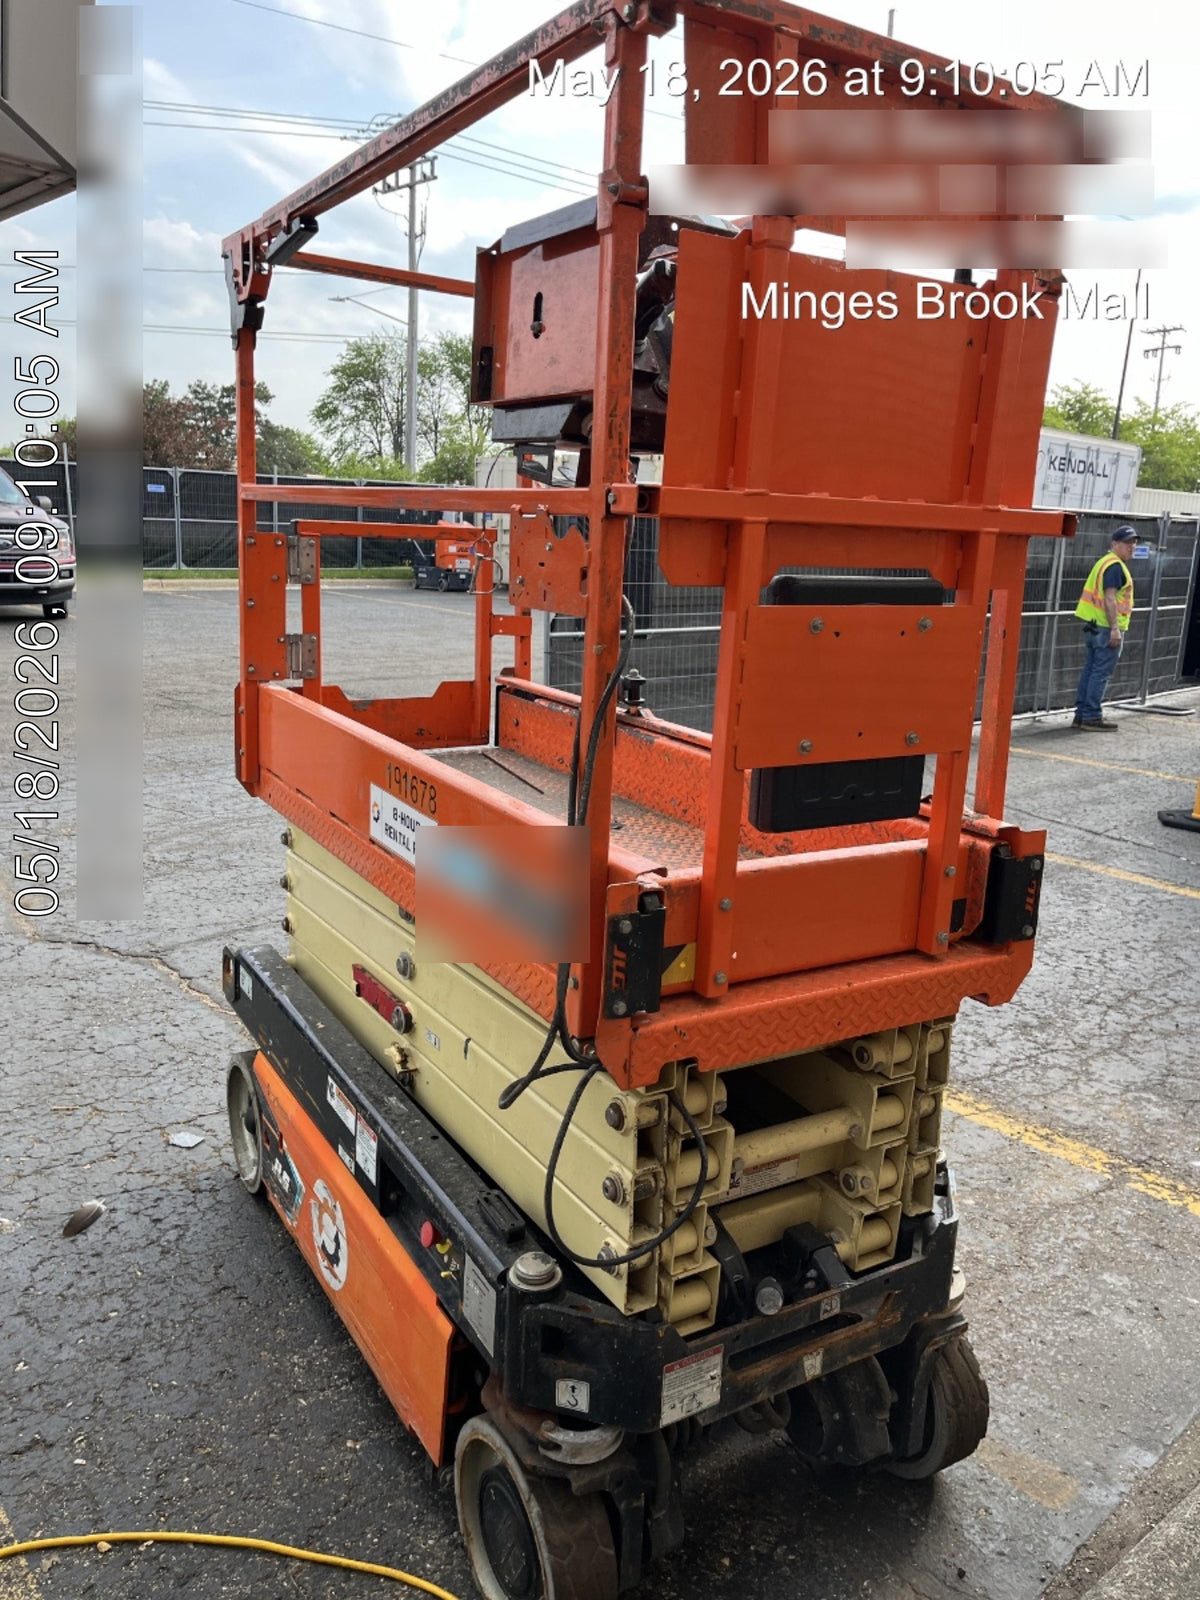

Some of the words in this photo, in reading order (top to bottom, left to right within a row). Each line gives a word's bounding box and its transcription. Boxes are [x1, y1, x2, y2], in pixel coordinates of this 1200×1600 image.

[1047, 454, 1109, 478] KENDALL
[386, 762, 437, 815] 191678
[612, 943, 629, 993] JLG
